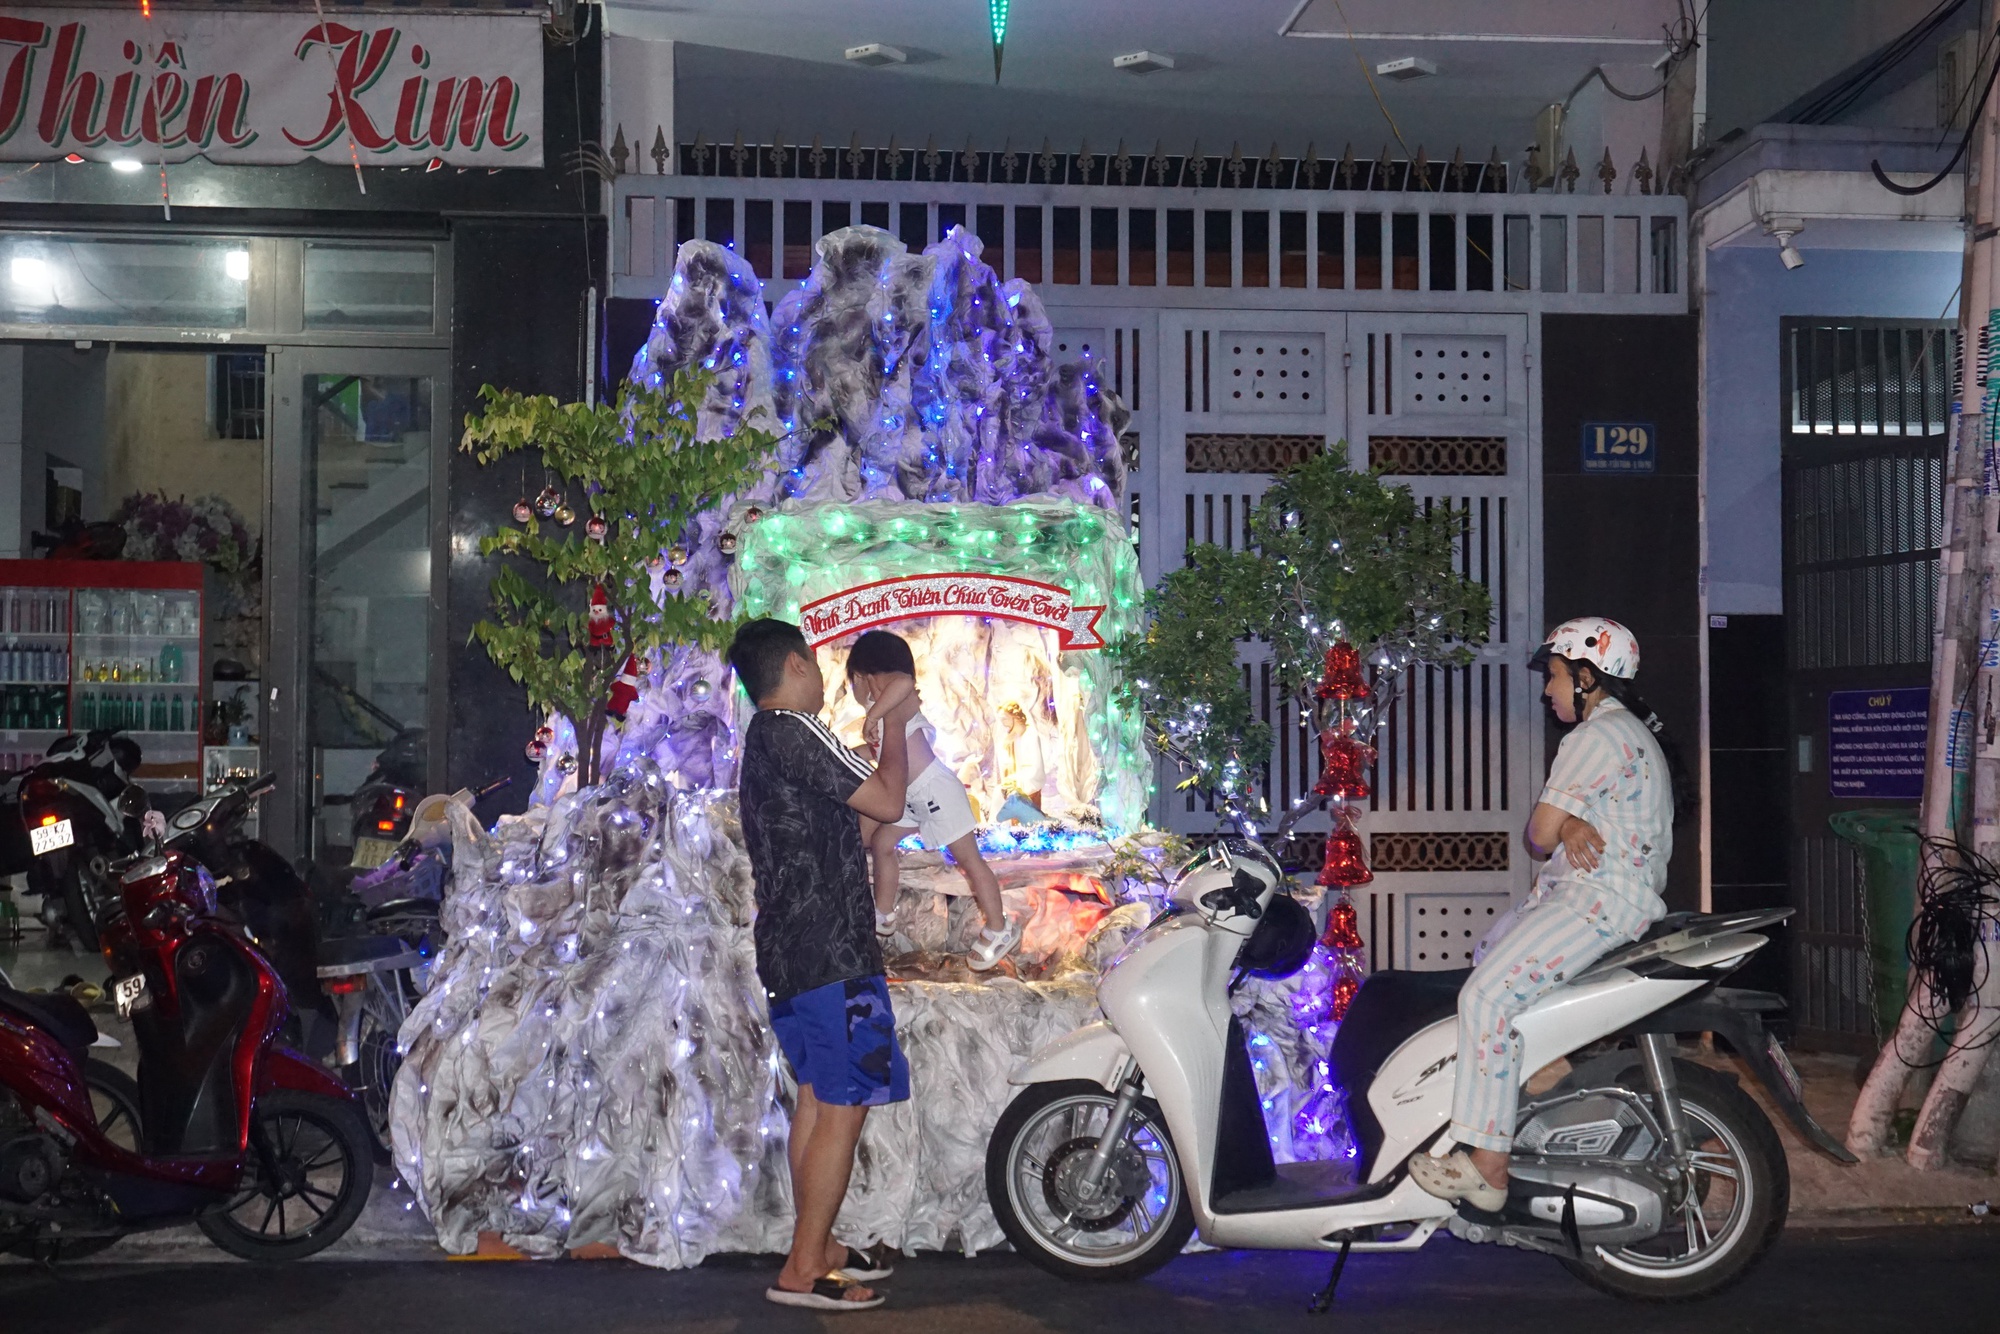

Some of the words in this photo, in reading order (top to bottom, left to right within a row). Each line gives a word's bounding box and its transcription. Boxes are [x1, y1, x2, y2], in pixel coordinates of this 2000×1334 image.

[0, 16, 258, 148] Thiên
[281, 22, 529, 153] Kim
[1594, 426, 1648, 455] 129
[844, 592, 891, 623] Danh
[893, 586, 941, 608] Thiên
[943, 584, 986, 606] Chúa
[987, 586, 1030, 612] Trên
